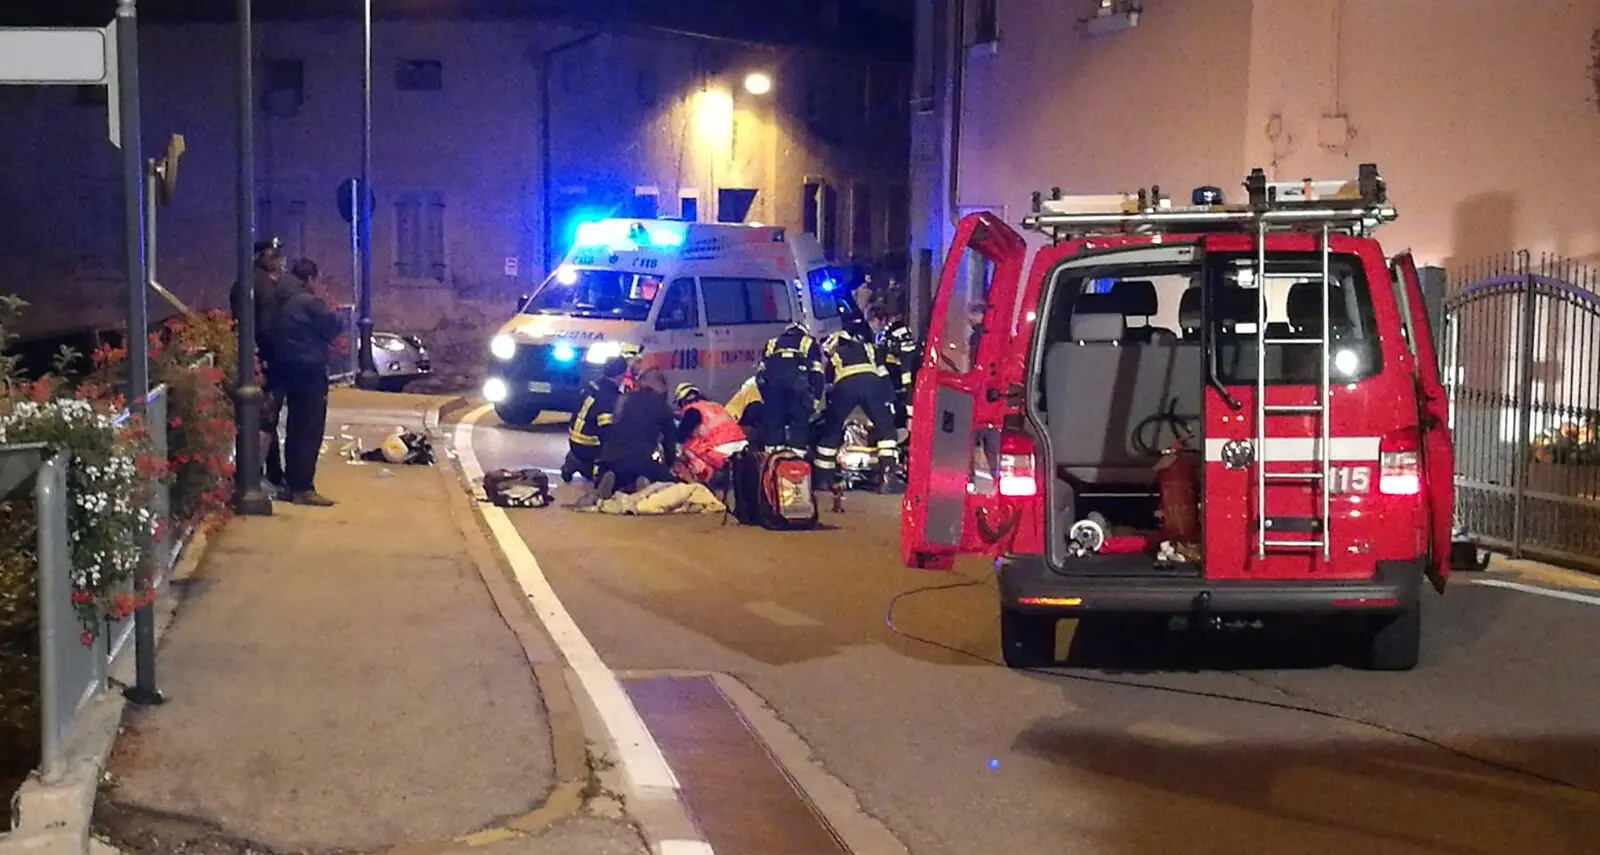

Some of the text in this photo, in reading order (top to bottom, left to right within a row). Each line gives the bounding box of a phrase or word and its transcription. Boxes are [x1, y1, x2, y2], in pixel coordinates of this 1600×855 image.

[640, 258, 658, 269] 118
[678, 347, 698, 369] 118
[1328, 466, 1370, 493] 115
